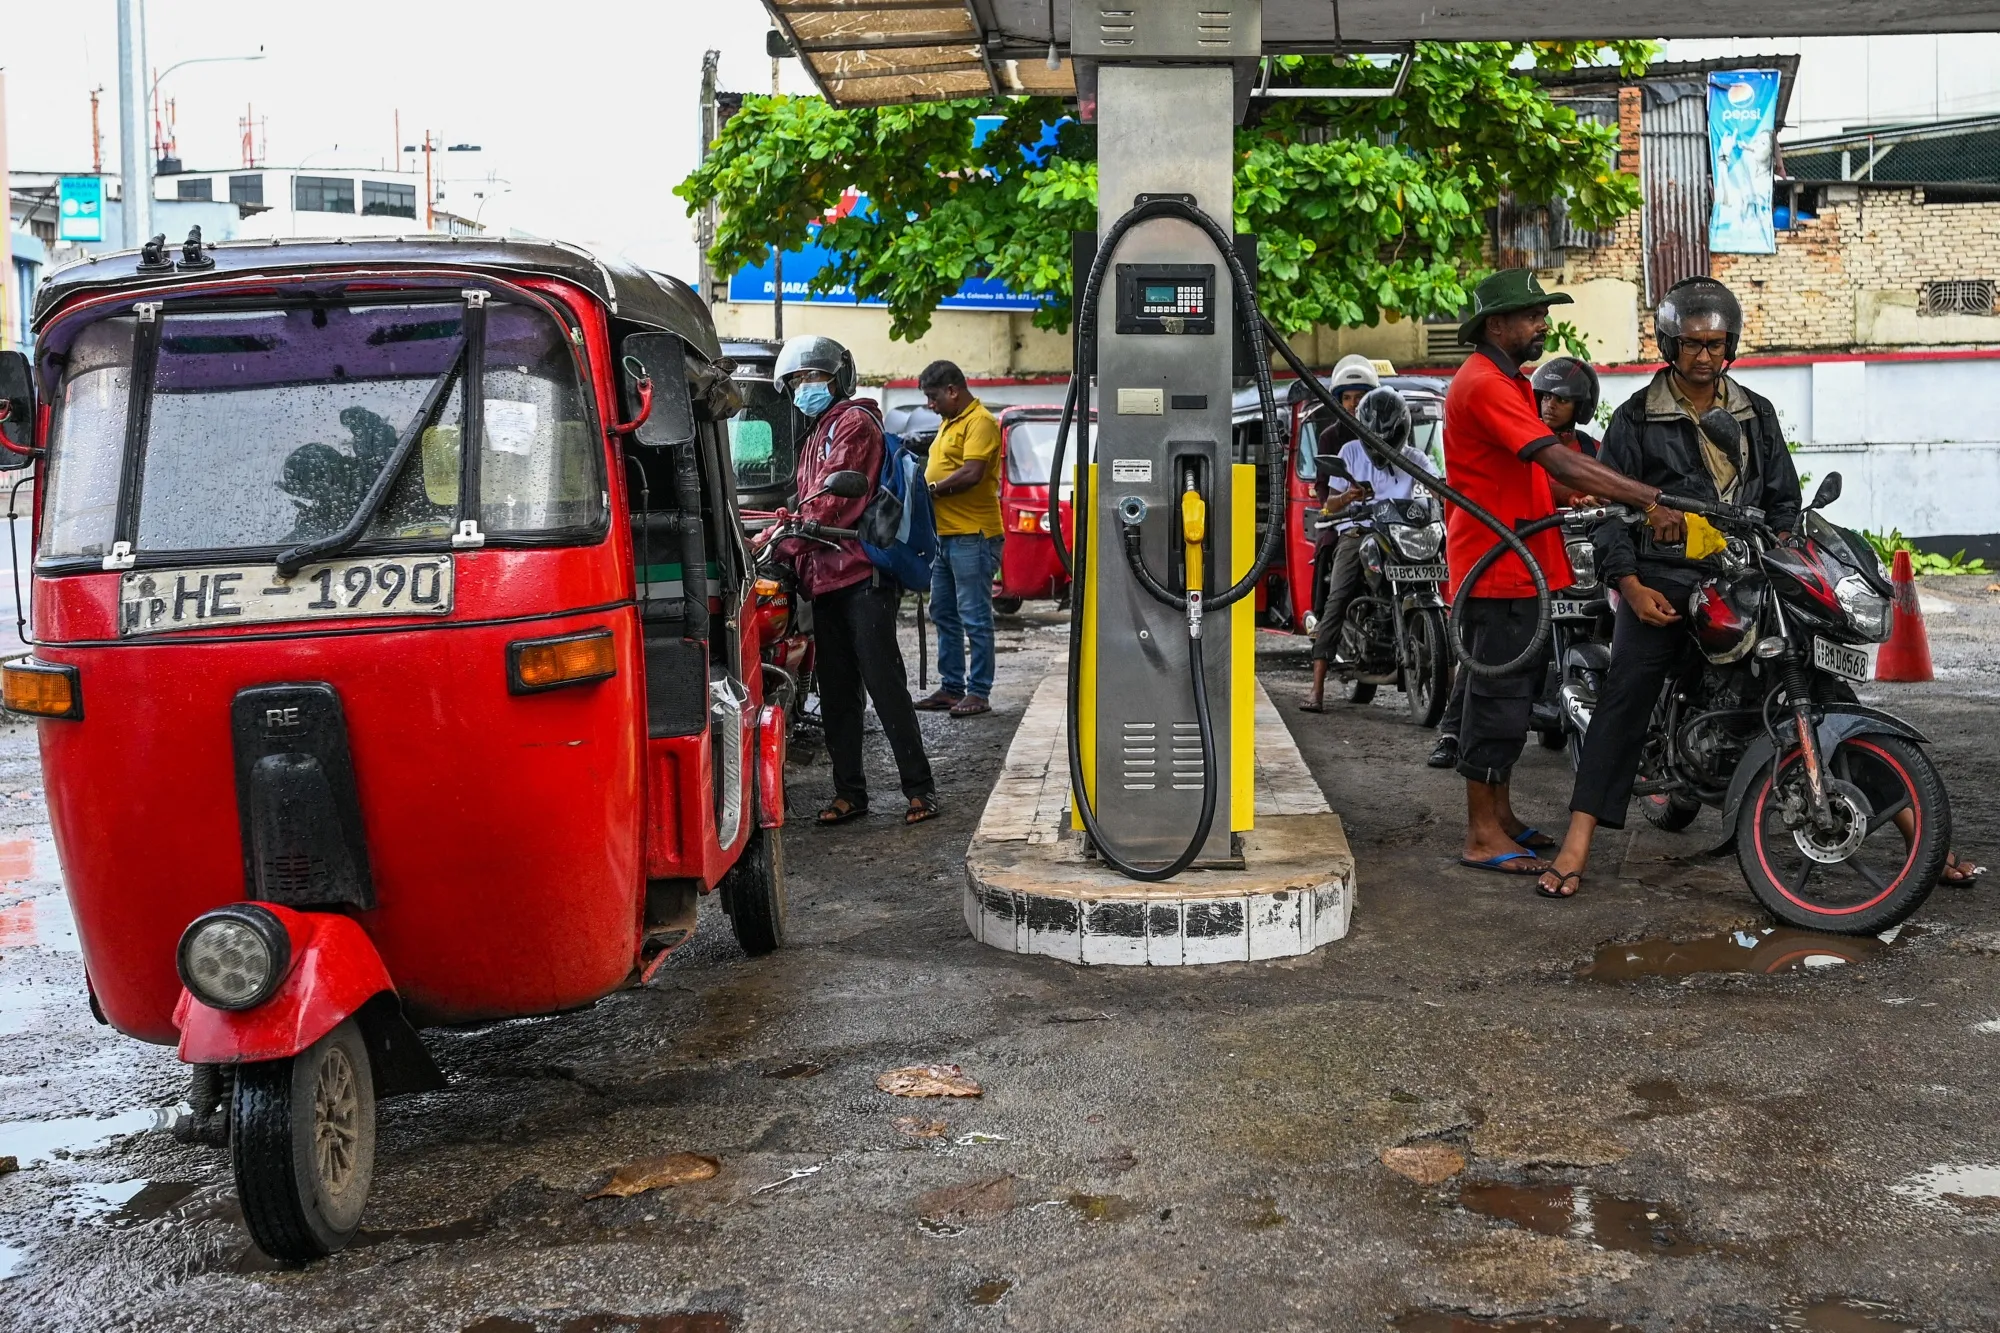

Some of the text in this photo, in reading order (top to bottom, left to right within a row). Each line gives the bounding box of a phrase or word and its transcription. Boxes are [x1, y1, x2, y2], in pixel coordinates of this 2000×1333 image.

[1722, 108, 1761, 122] pepsi
[125, 597, 166, 627] WP
[174, 572, 243, 621] HE
[308, 562, 441, 610] 1990
[771, 597, 788, 607] Hero
[266, 707, 300, 727] RE
